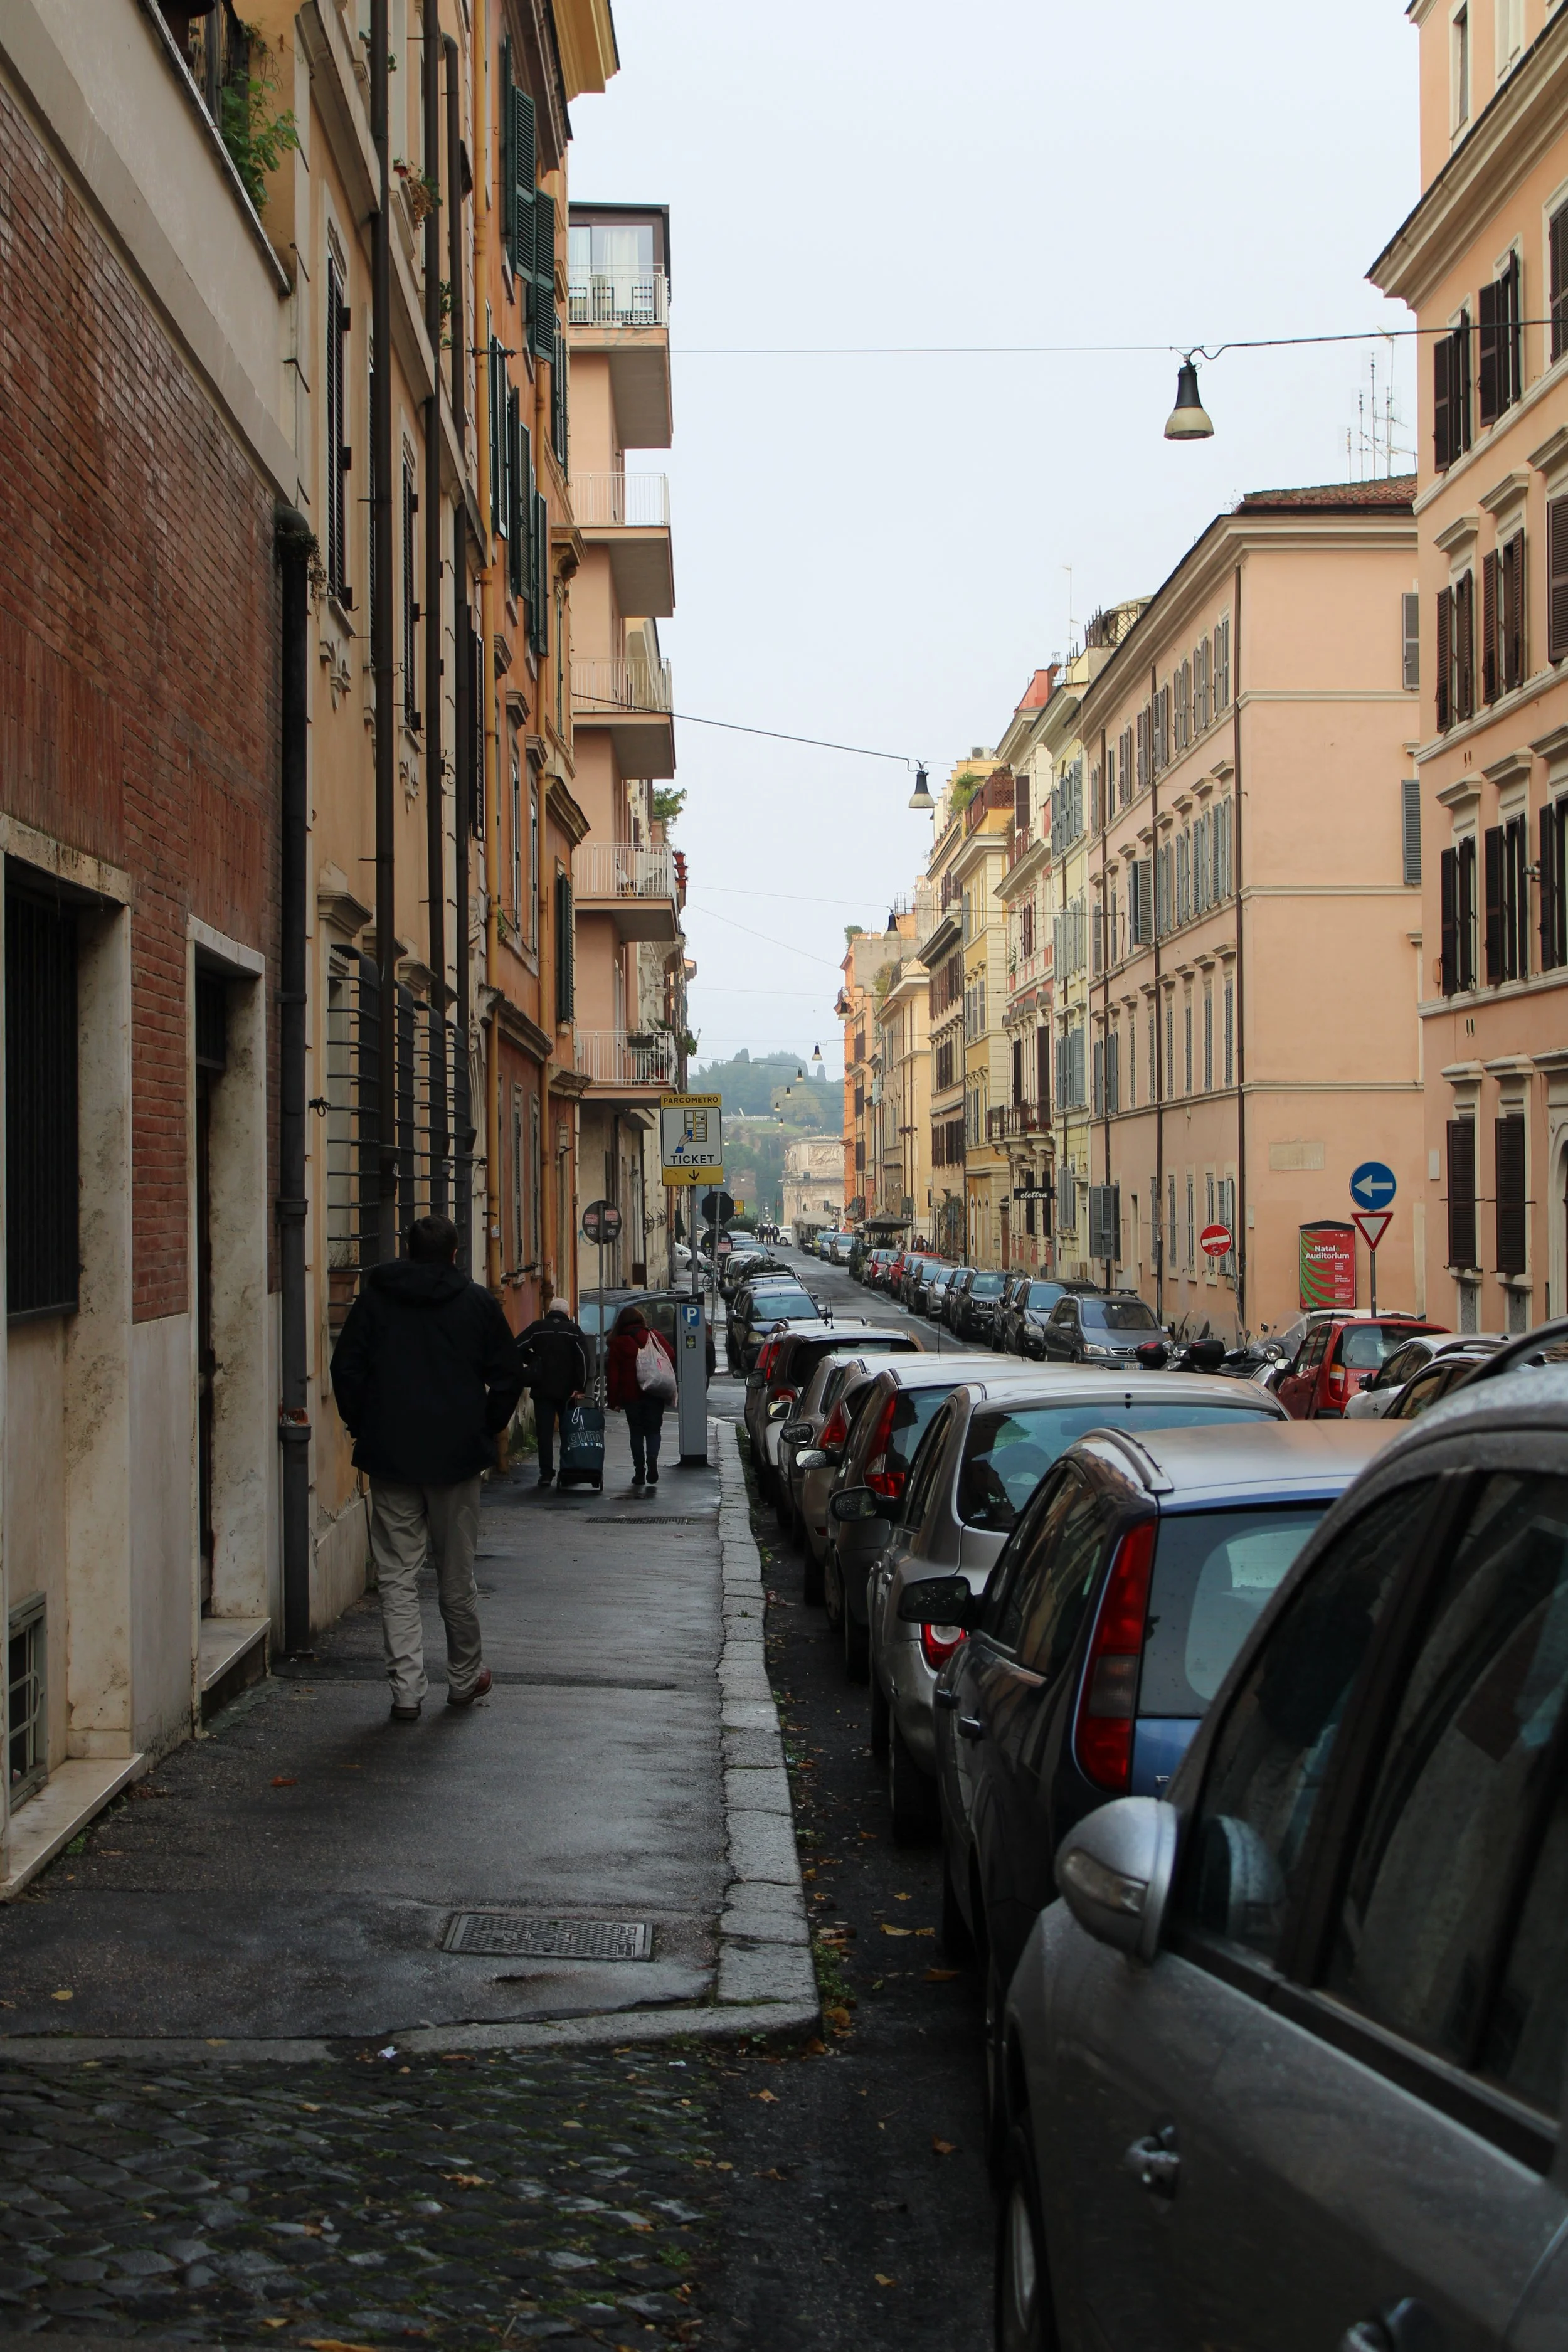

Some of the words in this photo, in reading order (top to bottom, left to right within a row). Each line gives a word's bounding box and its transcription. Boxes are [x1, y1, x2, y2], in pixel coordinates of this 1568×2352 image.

[670, 1154, 714, 1164] TICKET
[1020, 1190, 1047, 1199] elettra
[687, 1308, 697, 1323] P
